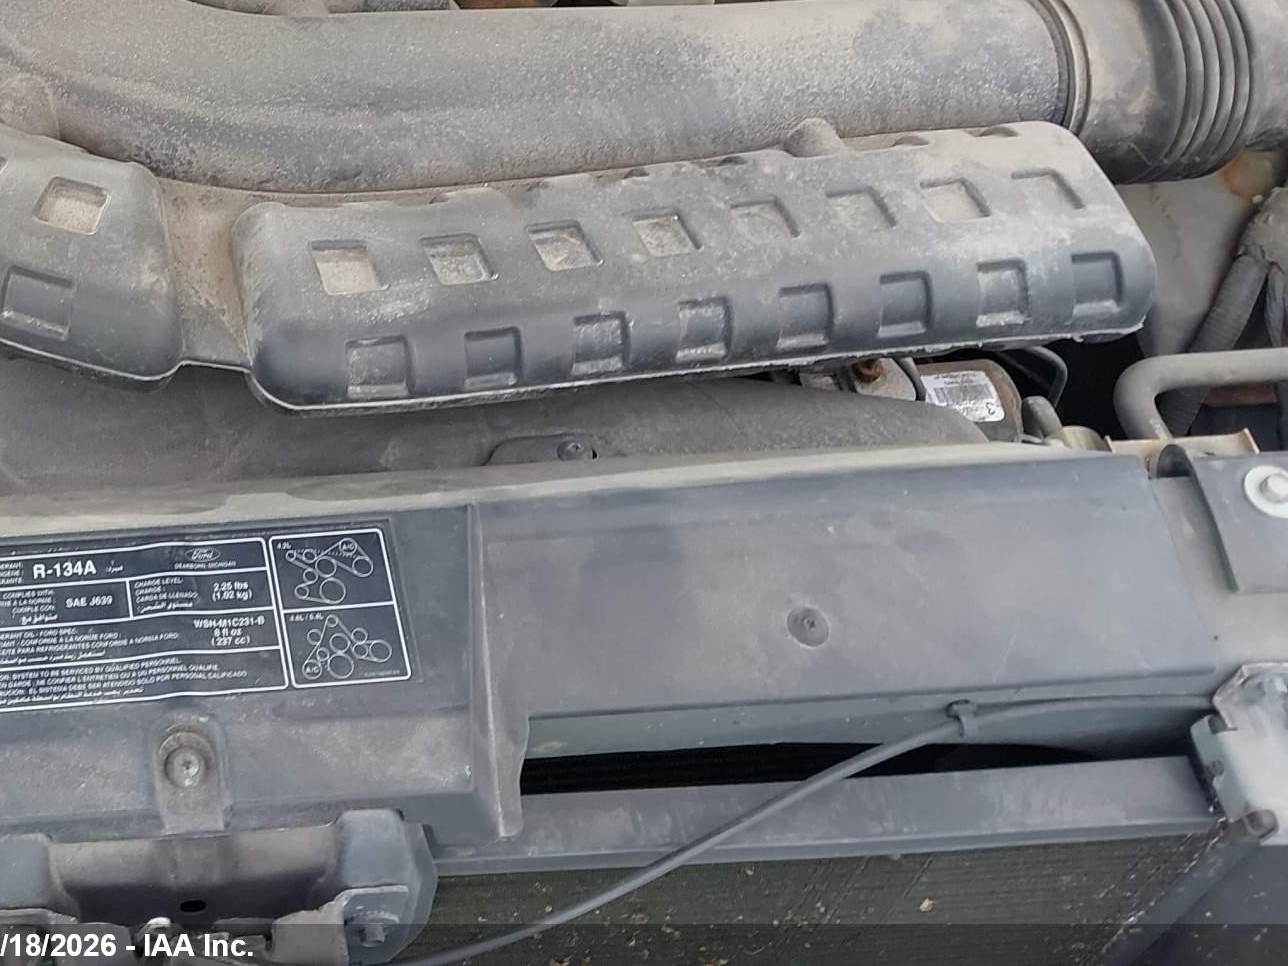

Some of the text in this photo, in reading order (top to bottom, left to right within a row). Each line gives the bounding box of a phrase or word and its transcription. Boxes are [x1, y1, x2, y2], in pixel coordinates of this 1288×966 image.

[32, 559, 96, 579] R-134A
[212, 580, 248, 591] 2.25 lbs
[235, 589, 252, 599] kg)
[65, 594, 112, 607] SAE J639
